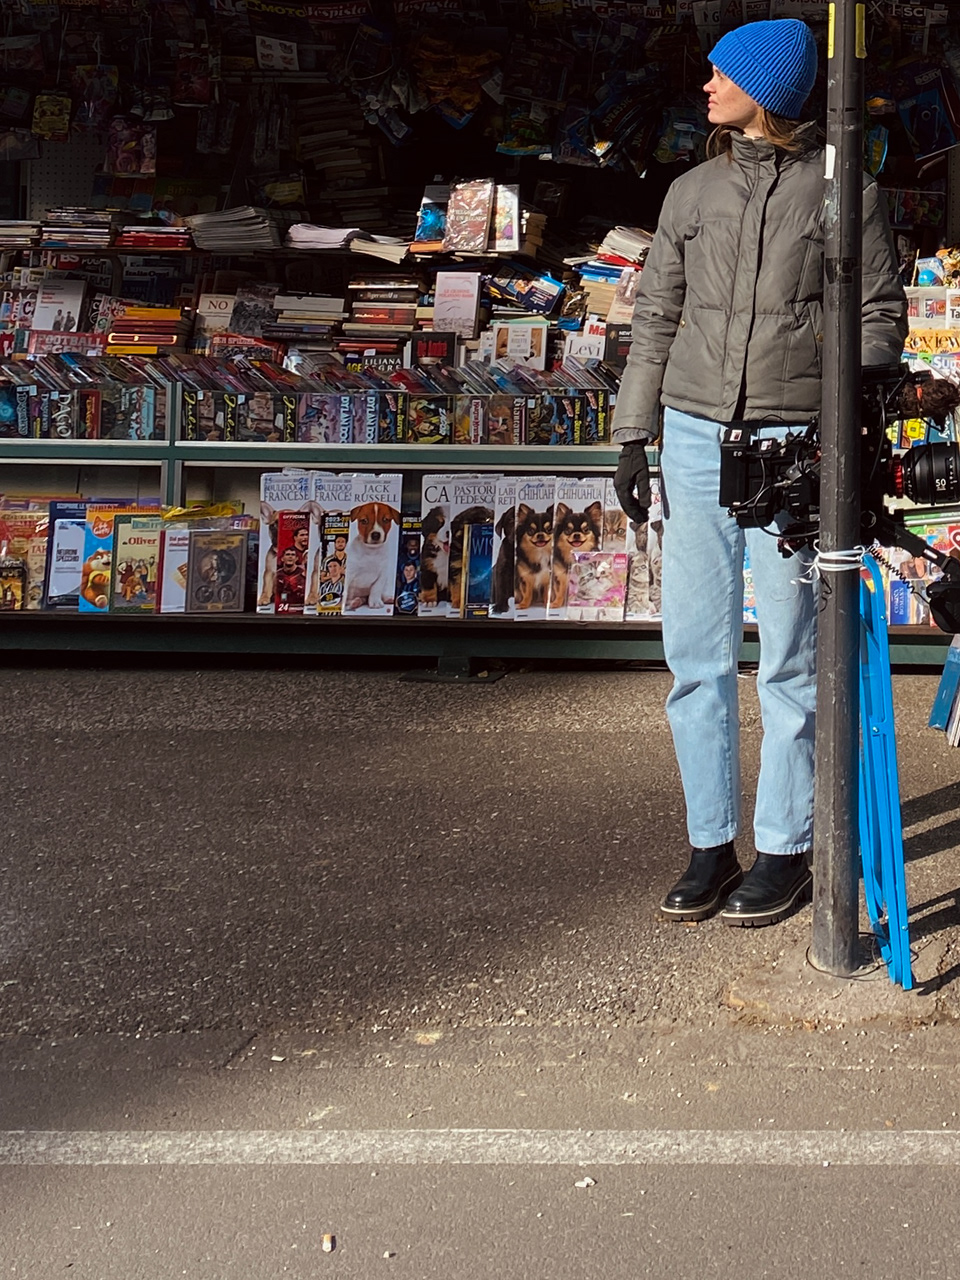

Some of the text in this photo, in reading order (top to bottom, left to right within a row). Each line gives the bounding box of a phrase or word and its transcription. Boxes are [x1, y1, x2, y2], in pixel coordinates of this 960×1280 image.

[261, 3, 306, 18] MOTO
[306, 2, 368, 20] Vespista
[207, 300, 229, 310] NO
[37, 333, 103, 345] FOOTBALL
[568, 340, 601, 355] Levi
[57, 393, 73, 438] DAGO
[184, 391, 197, 441] Julia
[223, 393, 237, 442] Julia
[340, 396, 350, 425] DYLAN
[366, 396, 376, 425] DYLAN
[282, 395, 296, 442] Julia
[364, 484, 390, 493] JACK
[935, 479, 946, 487] 50
[264, 491, 309, 502] FRANCESE
[354, 493, 399, 503] RUSSELL
[424, 485, 451, 503] CA
[557, 488, 602, 500] CHIHUAHUA
[128, 536, 158, 545] Oliver
[278, 604, 289, 612] 24
